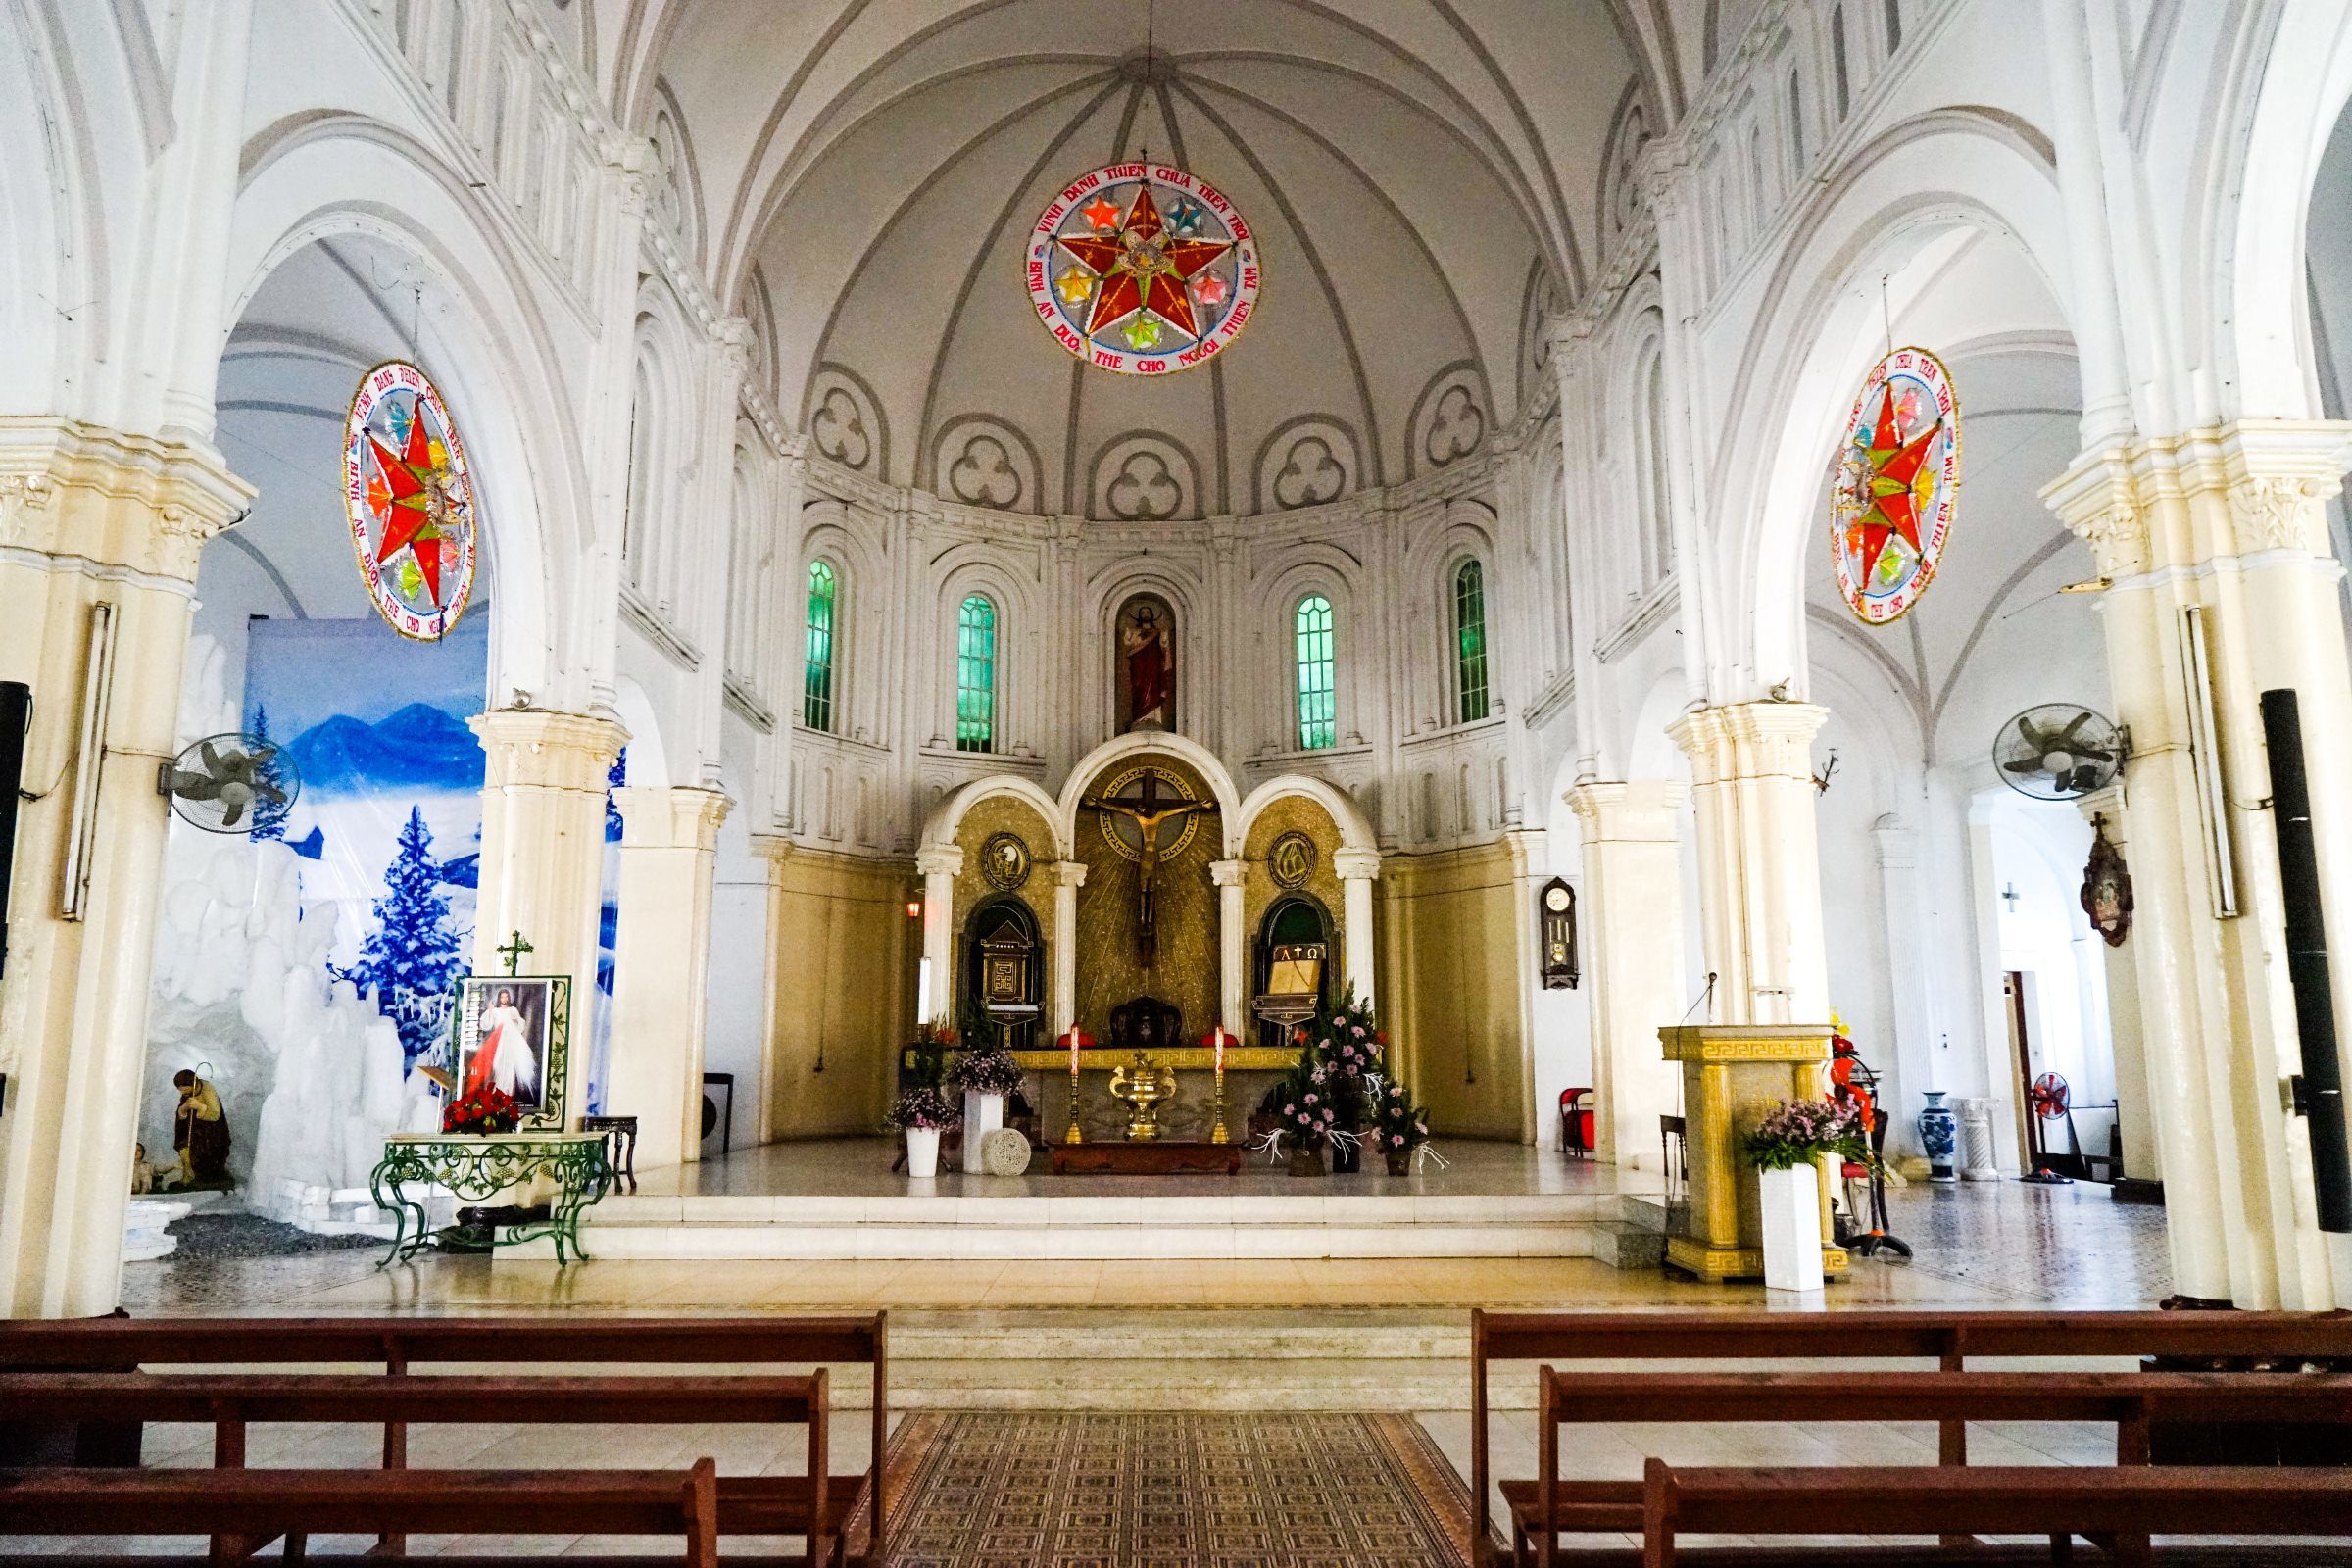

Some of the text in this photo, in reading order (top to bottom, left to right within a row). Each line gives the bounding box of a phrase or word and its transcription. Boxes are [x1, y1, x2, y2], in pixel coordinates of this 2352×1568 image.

[1038, 204, 1064, 233] VINH
[1063, 174, 1100, 202] DANH
[1104, 165, 1147, 180] THIEN
[1198, 184, 1230, 213] TREN
[1227, 214, 1250, 241] TROI
[1029, 261, 1045, 292] BINH
[1037, 302, 1055, 318] AN
[1095, 351, 1123, 368] THE
[1137, 360, 1166, 372] CHO
[1221, 300, 1251, 336] THIEN
[1244, 267, 1257, 290] TAM
[350, 461, 360, 501] BINH
[1930, 502, 1949, 549] THIEN
[1943, 455, 1954, 485] TAM
[354, 518, 366, 538] AN
[384, 593, 400, 619] THE
[406, 615, 419, 633] CHO
[1281, 948, 1317, 960] A Ω
